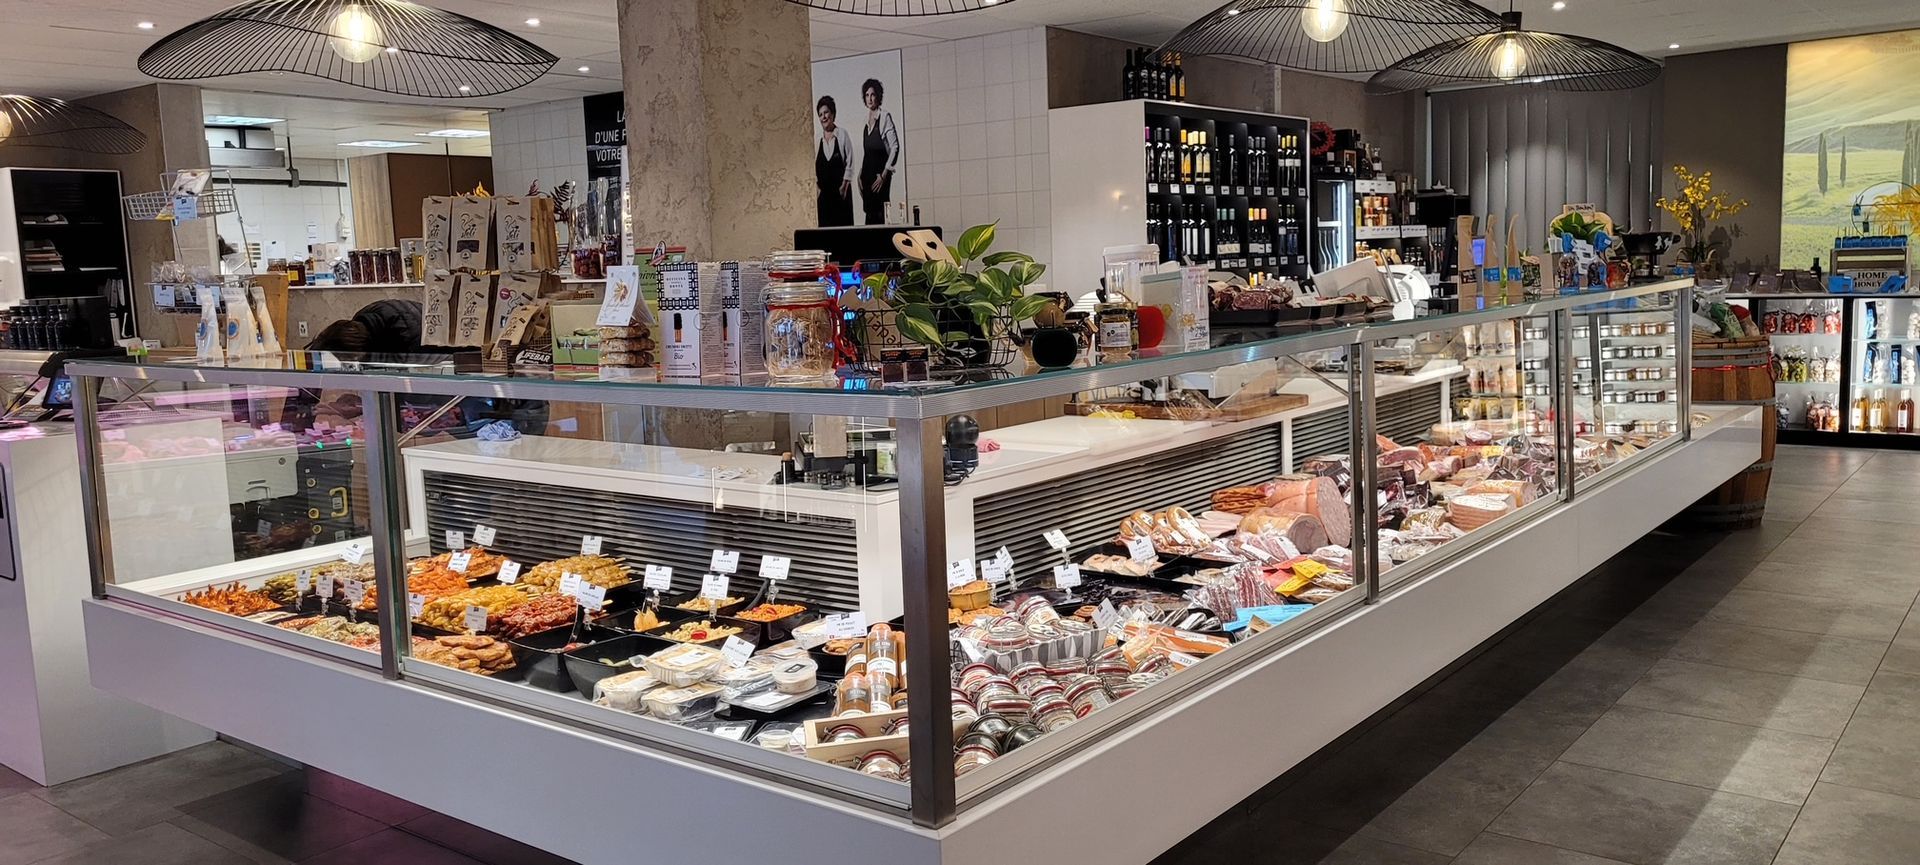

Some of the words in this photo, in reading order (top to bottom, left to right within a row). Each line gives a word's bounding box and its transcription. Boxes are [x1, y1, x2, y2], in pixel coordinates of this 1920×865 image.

[595, 129, 620, 144] D'UNE
[595, 148, 622, 162] VOTRE
[1857, 271, 1888, 279] HOME
[867, 311, 899, 348] Tapa
[516, 349, 551, 364] LIFEBAR
